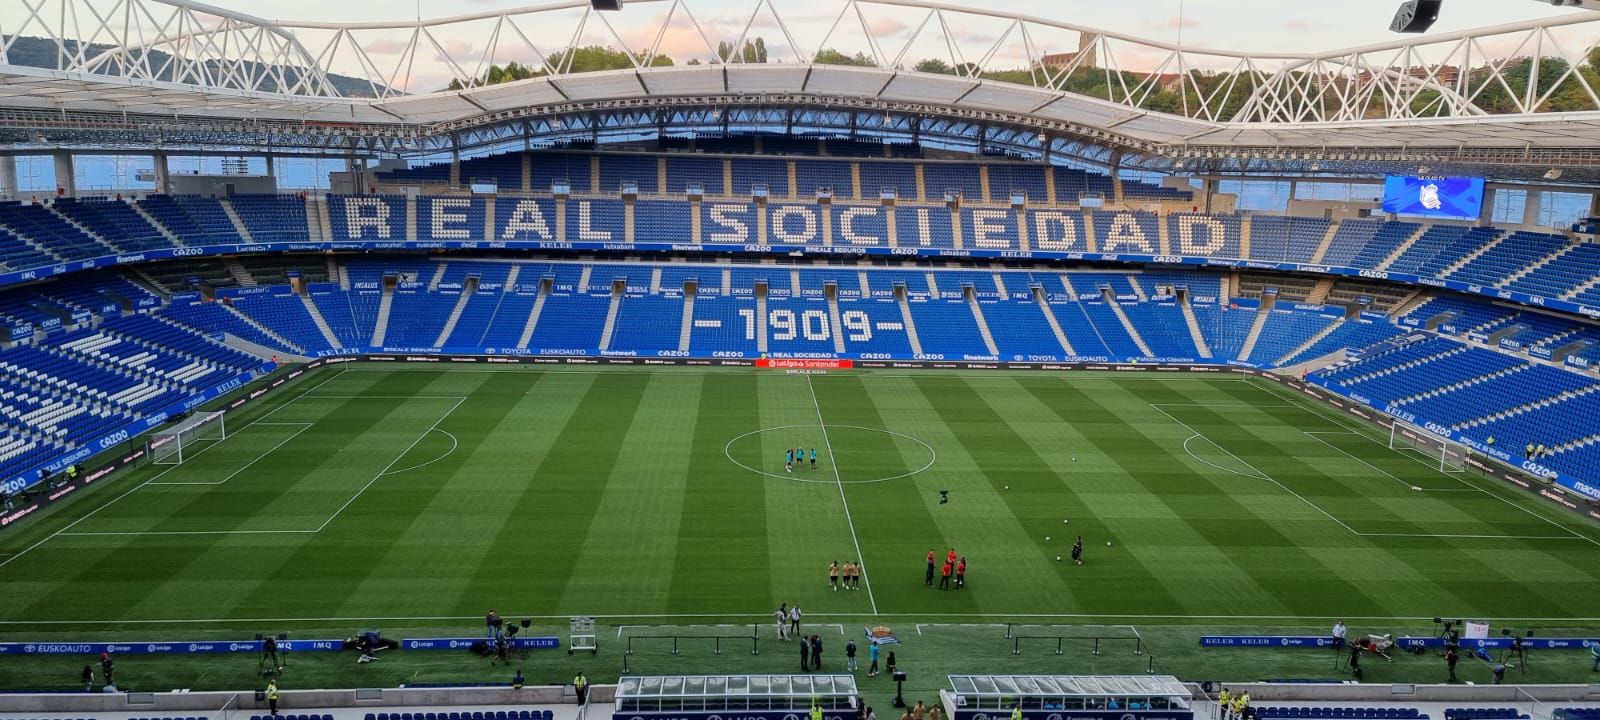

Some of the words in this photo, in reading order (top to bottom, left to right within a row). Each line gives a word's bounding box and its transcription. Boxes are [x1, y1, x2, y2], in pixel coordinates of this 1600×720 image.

[345, 198, 611, 240] REAL
[711, 204, 1225, 256] SOCIEDAD
[173, 248, 203, 256] CAZOO
[21, 270, 36, 280] IMQ
[1359, 270, 1388, 279] CAZOO
[1530, 296, 1544, 306] IMQ
[42, 318, 60, 328] CAZOO
[12, 325, 32, 336] CAZOO
[1500, 338, 1520, 348] CAZOO
[317, 348, 360, 357] KELER
[1530, 345, 1550, 356] CAZOO
[216, 378, 242, 393] KELER
[1384, 405, 1415, 422] KELER
[1424, 422, 1452, 437] CAZOO
[100, 430, 128, 448] CAZOO
